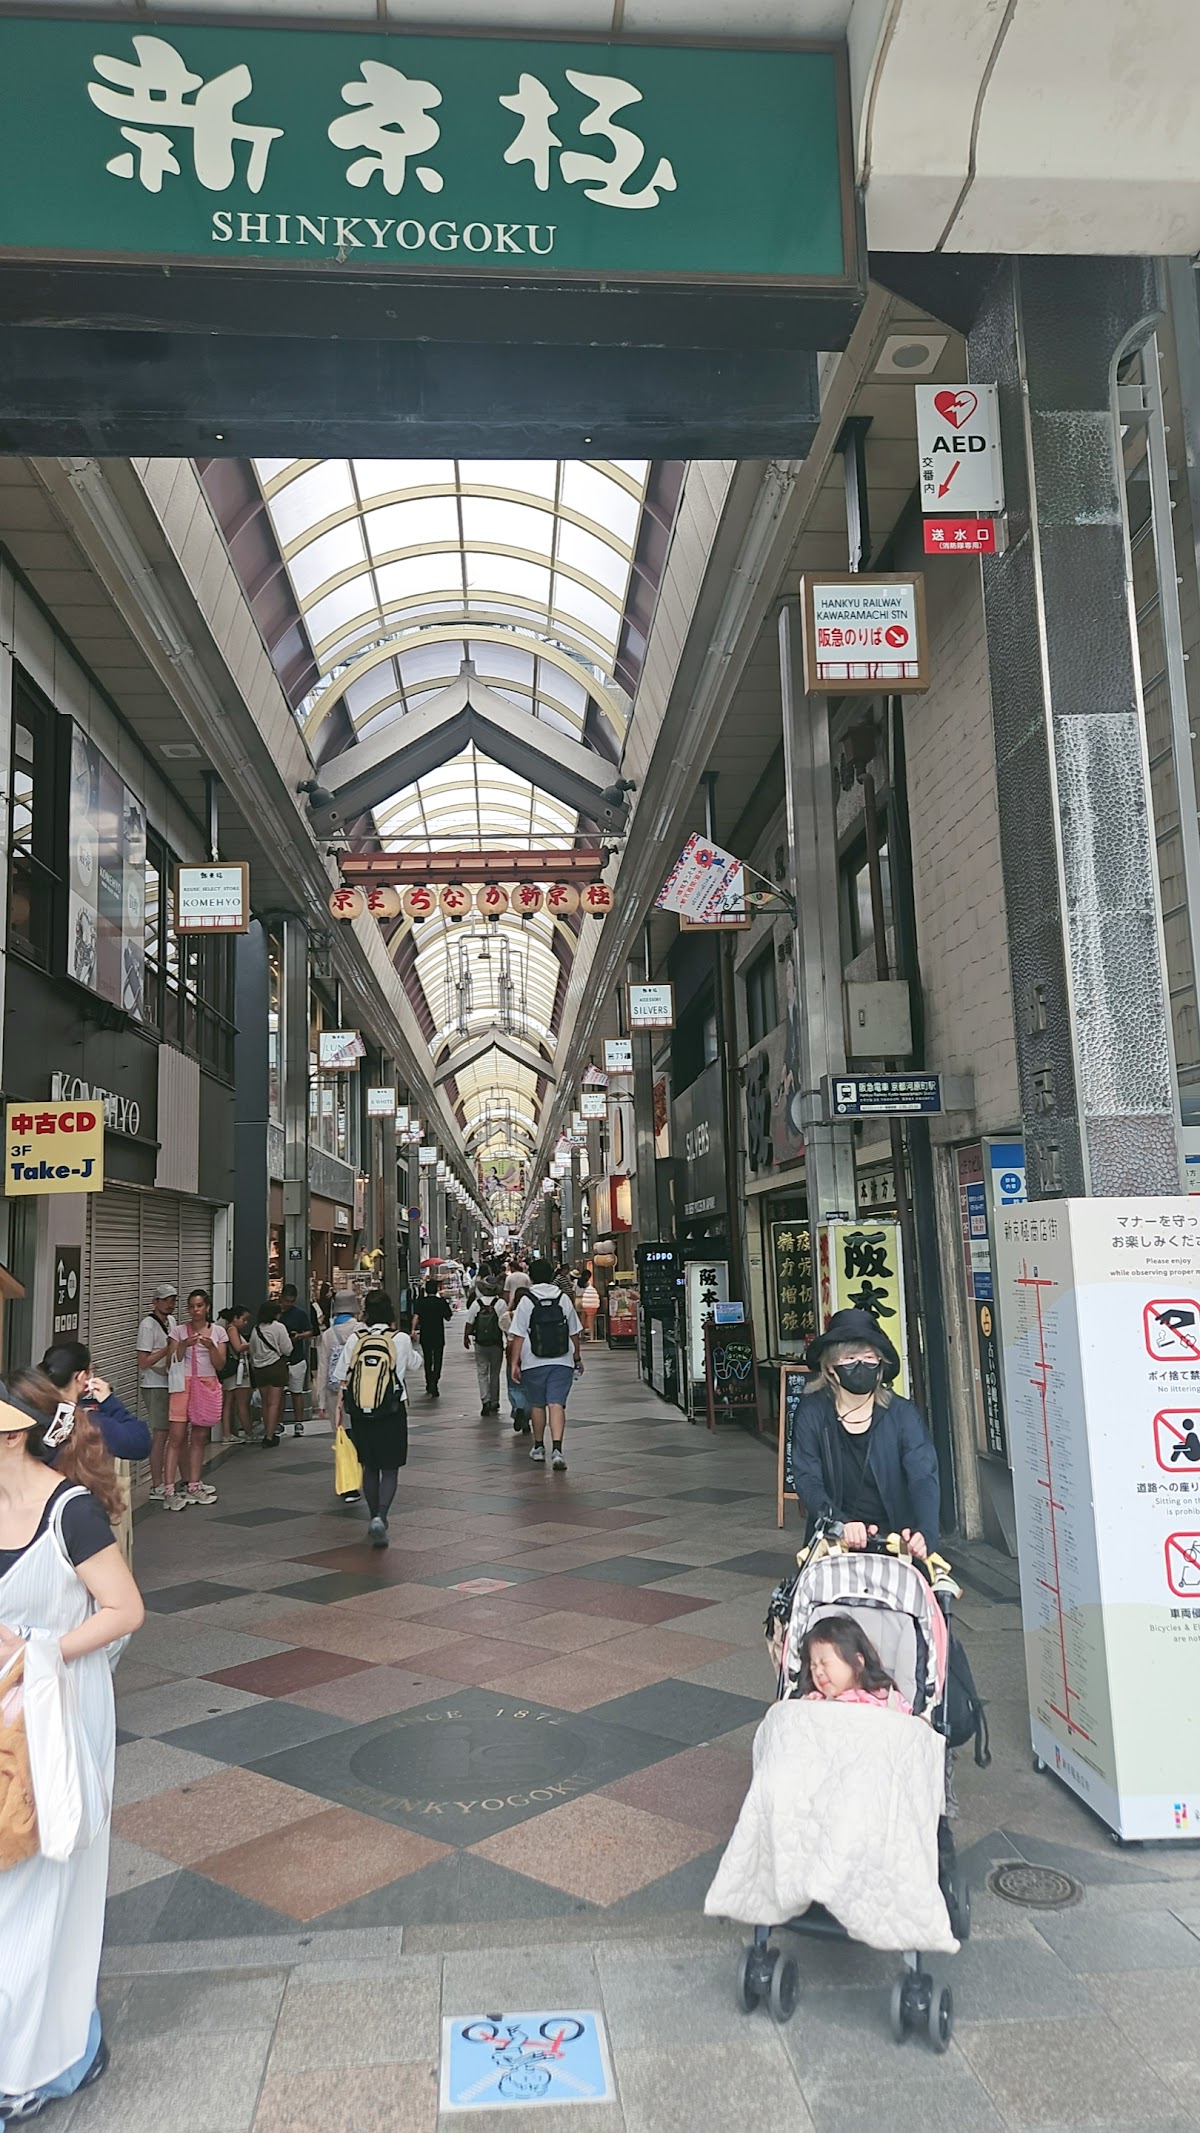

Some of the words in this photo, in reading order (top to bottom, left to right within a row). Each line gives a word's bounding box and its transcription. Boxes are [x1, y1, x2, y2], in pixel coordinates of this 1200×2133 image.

[88, 35, 677, 209] 新京極
[211, 211, 557, 255] SHINKYOGOKU
[932, 435, 986, 453] AED
[922, 457, 935, 494] 交番内
[931, 529, 989, 541] 送水口
[821, 599, 860, 608] HANKYU
[863, 598, 902, 607] RAILWAY
[817, 610, 888, 620] KAWARAMACHI
[891, 610, 908, 619] STN
[818, 626, 883, 647] 阪急のりば
[183, 898, 241, 907] KOMEHYO
[633, 1006, 668, 1015] SILVERS
[859, 1082, 889, 1092] 阪急電車
[891, 1081, 936, 1091] 京都河原町駅
[12, 1112, 96, 1135] 中古CD
[686, 1120, 710, 1162] SILVERS
[11, 1145, 32, 1157] 3F
[11, 1158, 95, 1180] Take-J
[1117, 1214, 1198, 1228] マナーを守っ
[1004, 1217, 1058, 1242] 新京極商店街
[1171, 1257, 1191, 1265] enjoy
[1170, 1385, 1200, 1393] littering
[1137, 1482, 1199, 1493] 道路への座り
[1155, 1498, 1181, 1506] Sitting
[1149, 1624, 1181, 1633] Bicycles
